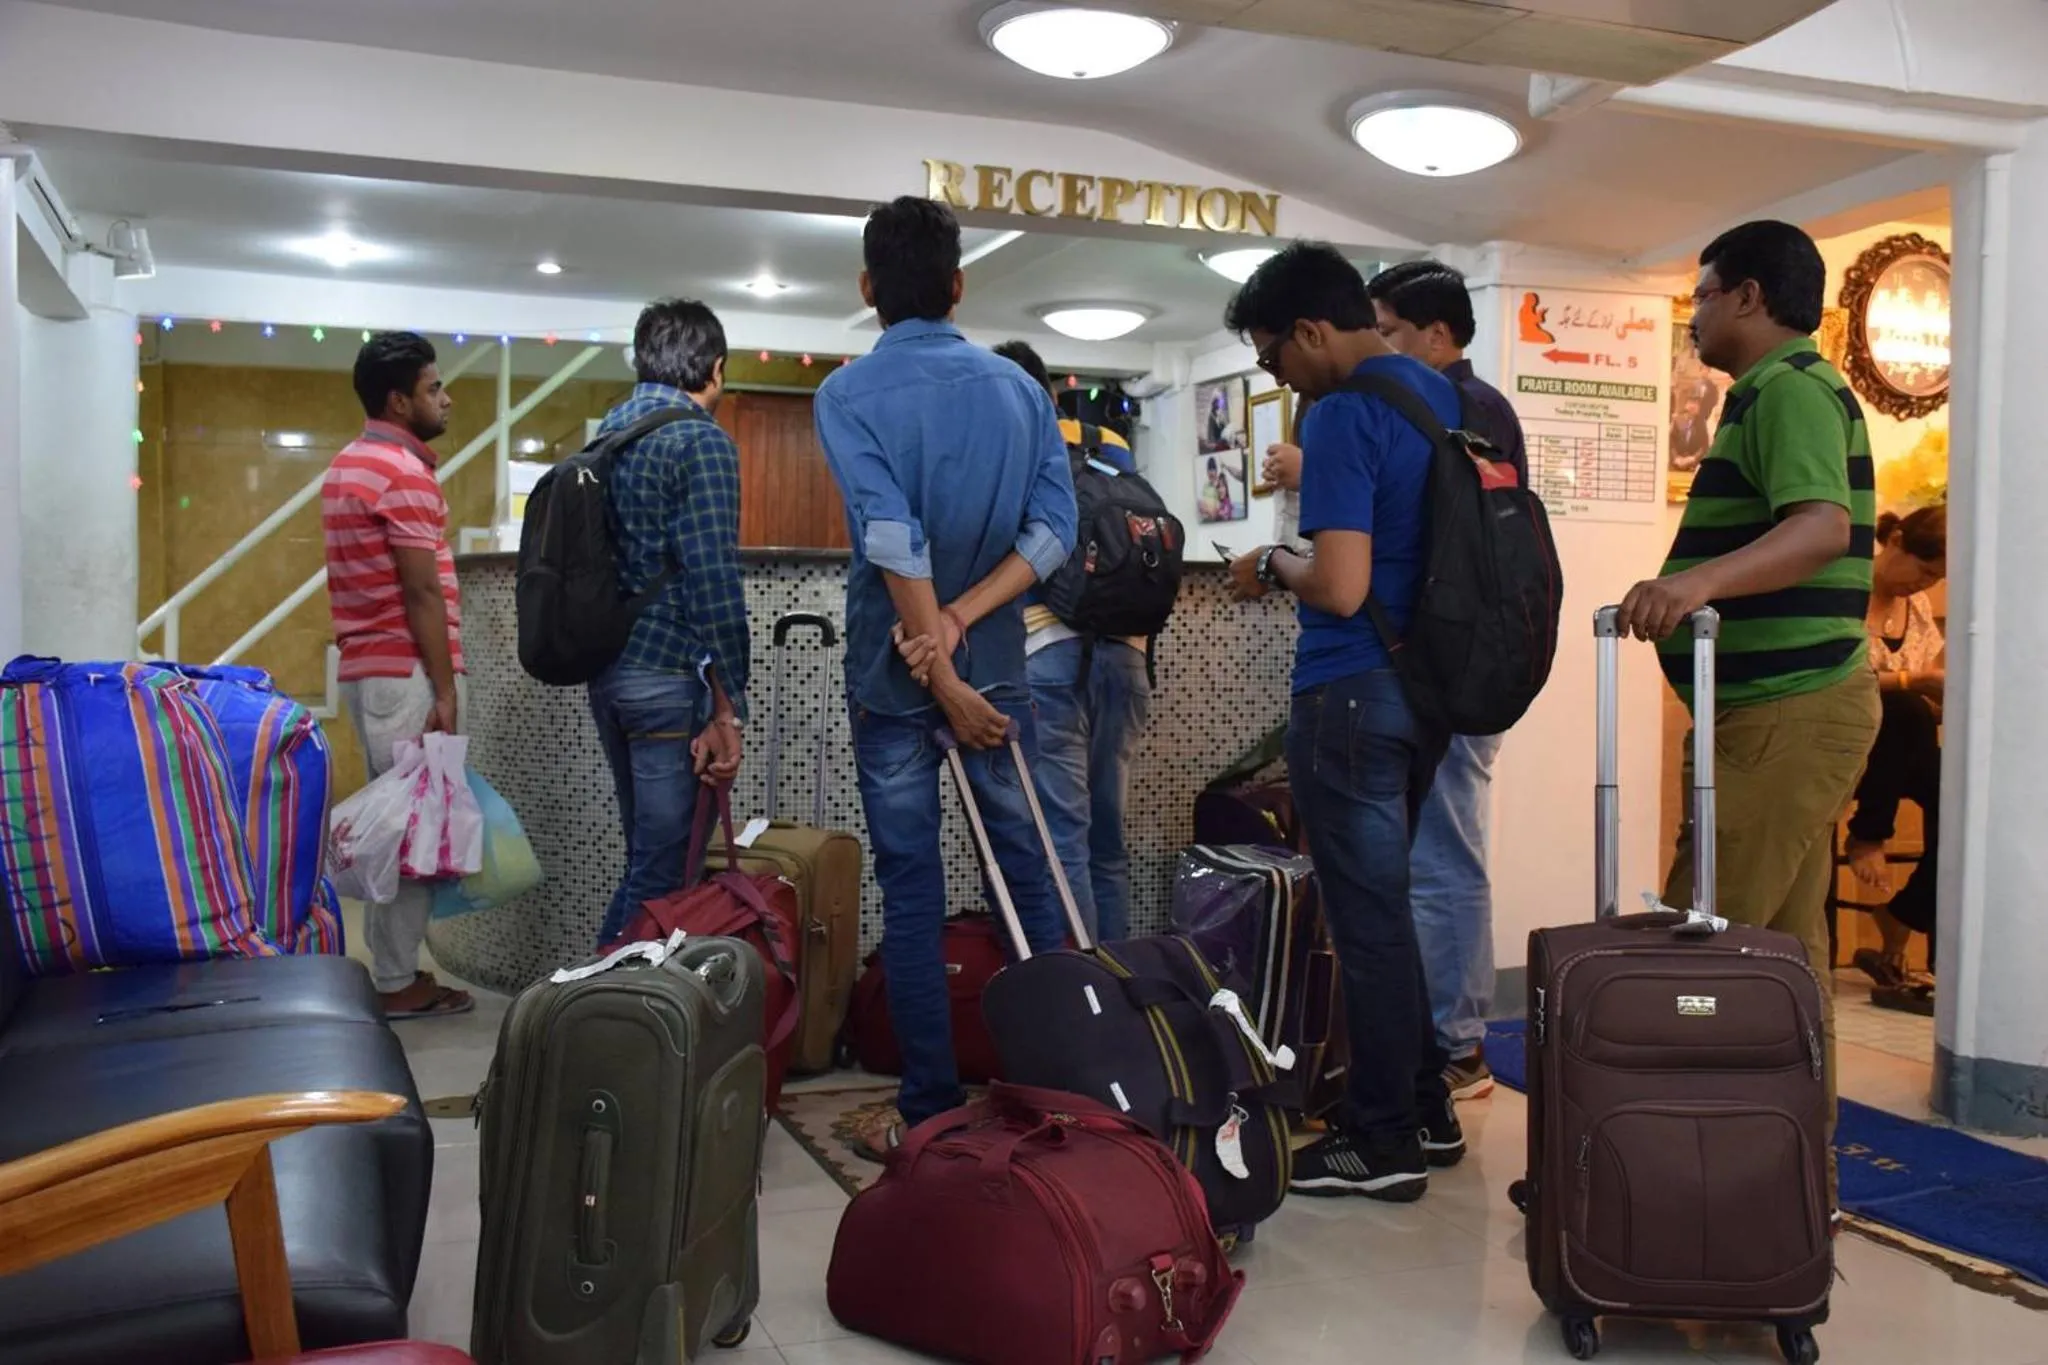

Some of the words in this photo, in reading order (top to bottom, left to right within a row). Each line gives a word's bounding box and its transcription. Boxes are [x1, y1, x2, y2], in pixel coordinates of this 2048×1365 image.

[922, 158, 1283, 236] RECEPTION
[1594, 353, 1621, 367] FL.
[1521, 378, 1562, 393] PRAYER
[1564, 381, 1597, 395] ROOM
[1599, 383, 1655, 400] AVAILABLE
